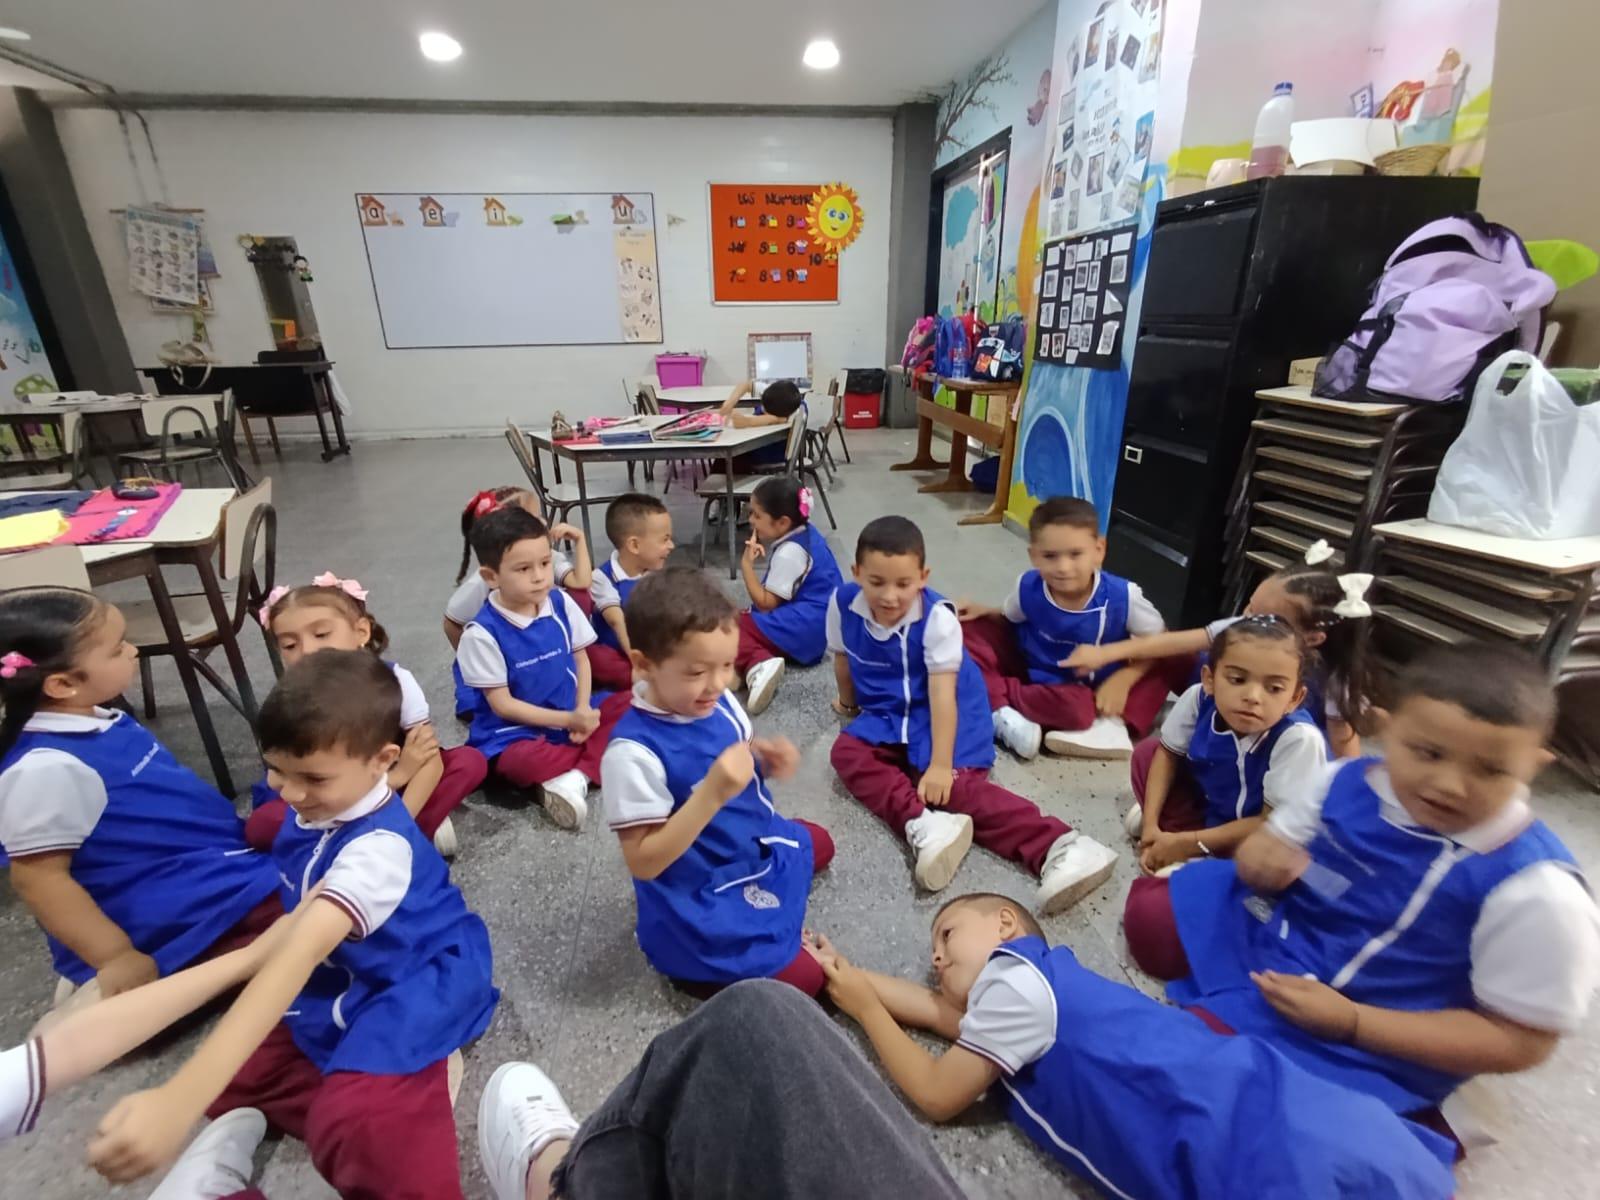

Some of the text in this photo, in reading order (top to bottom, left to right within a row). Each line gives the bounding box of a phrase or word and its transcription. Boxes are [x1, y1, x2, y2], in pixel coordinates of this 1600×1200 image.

[369, 207, 379, 218] a
[428, 208, 438, 220] e
[728, 215, 734, 228] 1
[759, 214, 767, 228] 2
[786, 214, 795, 228] 3
[728, 241, 736, 253] 4
[759, 241, 769, 255] 5
[787, 241, 796, 255] 6
[808, 253, 822, 266] 10
[729, 269, 737, 283] 7
[759, 269, 767, 283] 8
[786, 268, 795, 282] 9
